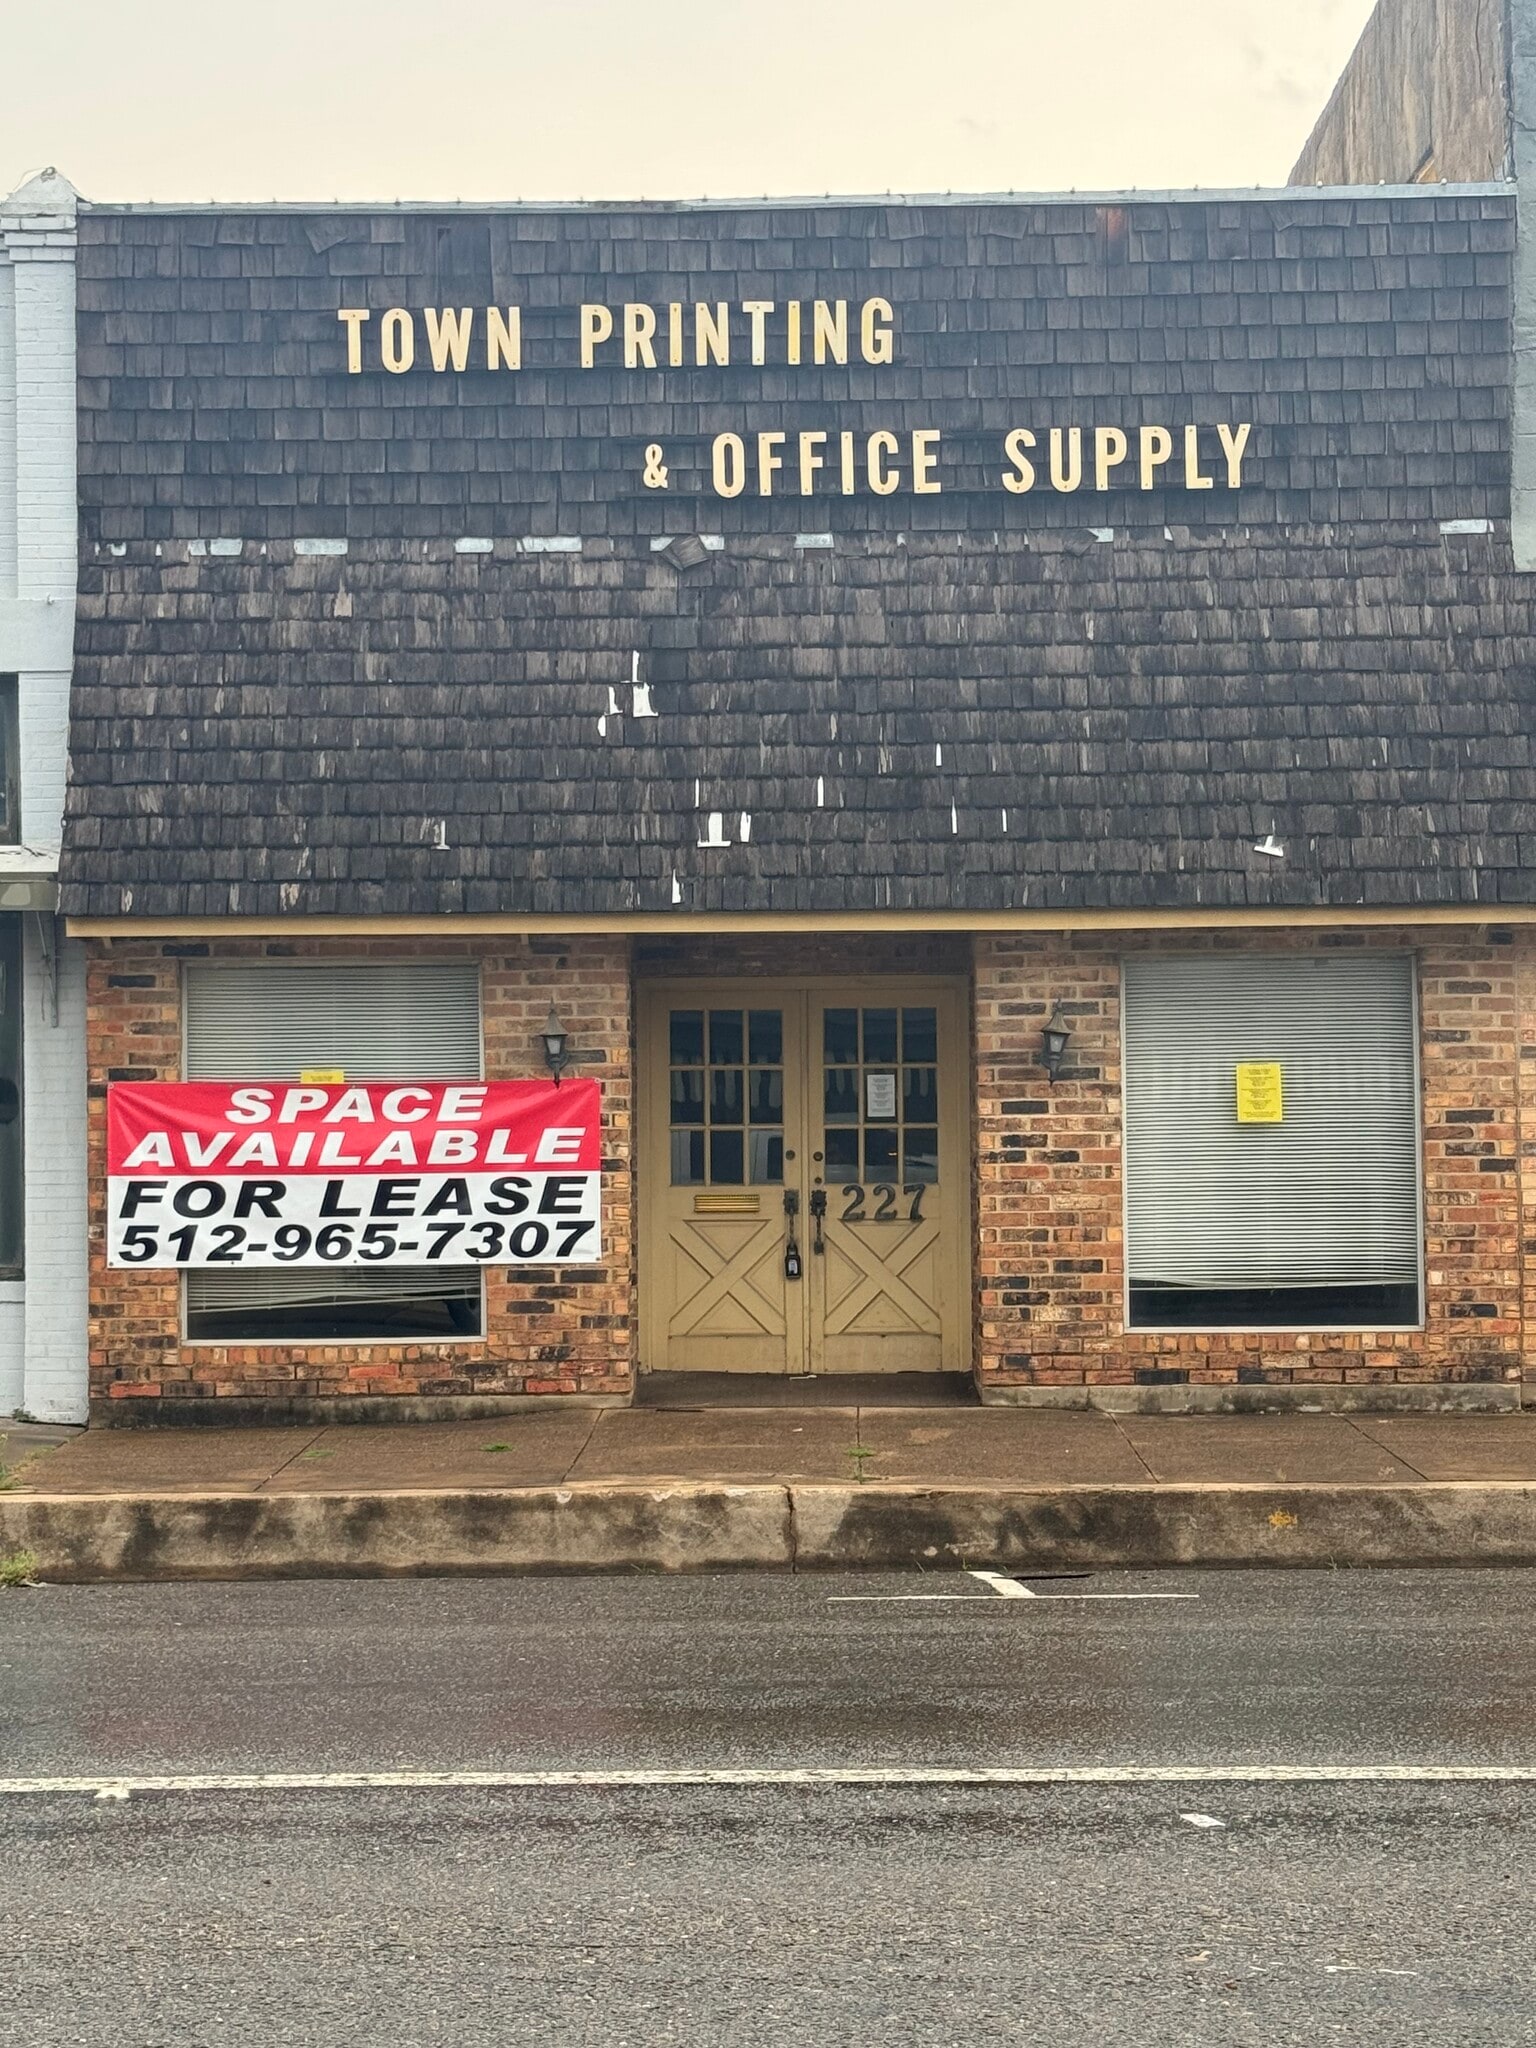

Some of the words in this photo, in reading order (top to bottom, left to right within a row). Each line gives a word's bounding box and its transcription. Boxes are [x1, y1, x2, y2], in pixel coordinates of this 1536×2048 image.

[338, 305, 521, 374] TOWN
[580, 297, 894, 368] PRINTING
[643, 444, 668, 489] &
[712, 430, 942, 498] OFFICE
[1001, 423, 1251, 495] SUPPLY
[225, 1086, 488, 1124] SPACE
[121, 1127, 586, 1168] AVAILABLE
[119, 1179, 287, 1219] FOR
[319, 1175, 588, 1218] LEASE
[842, 1183, 926, 1222] 227
[119, 1220, 596, 1263] 512-965-7307
